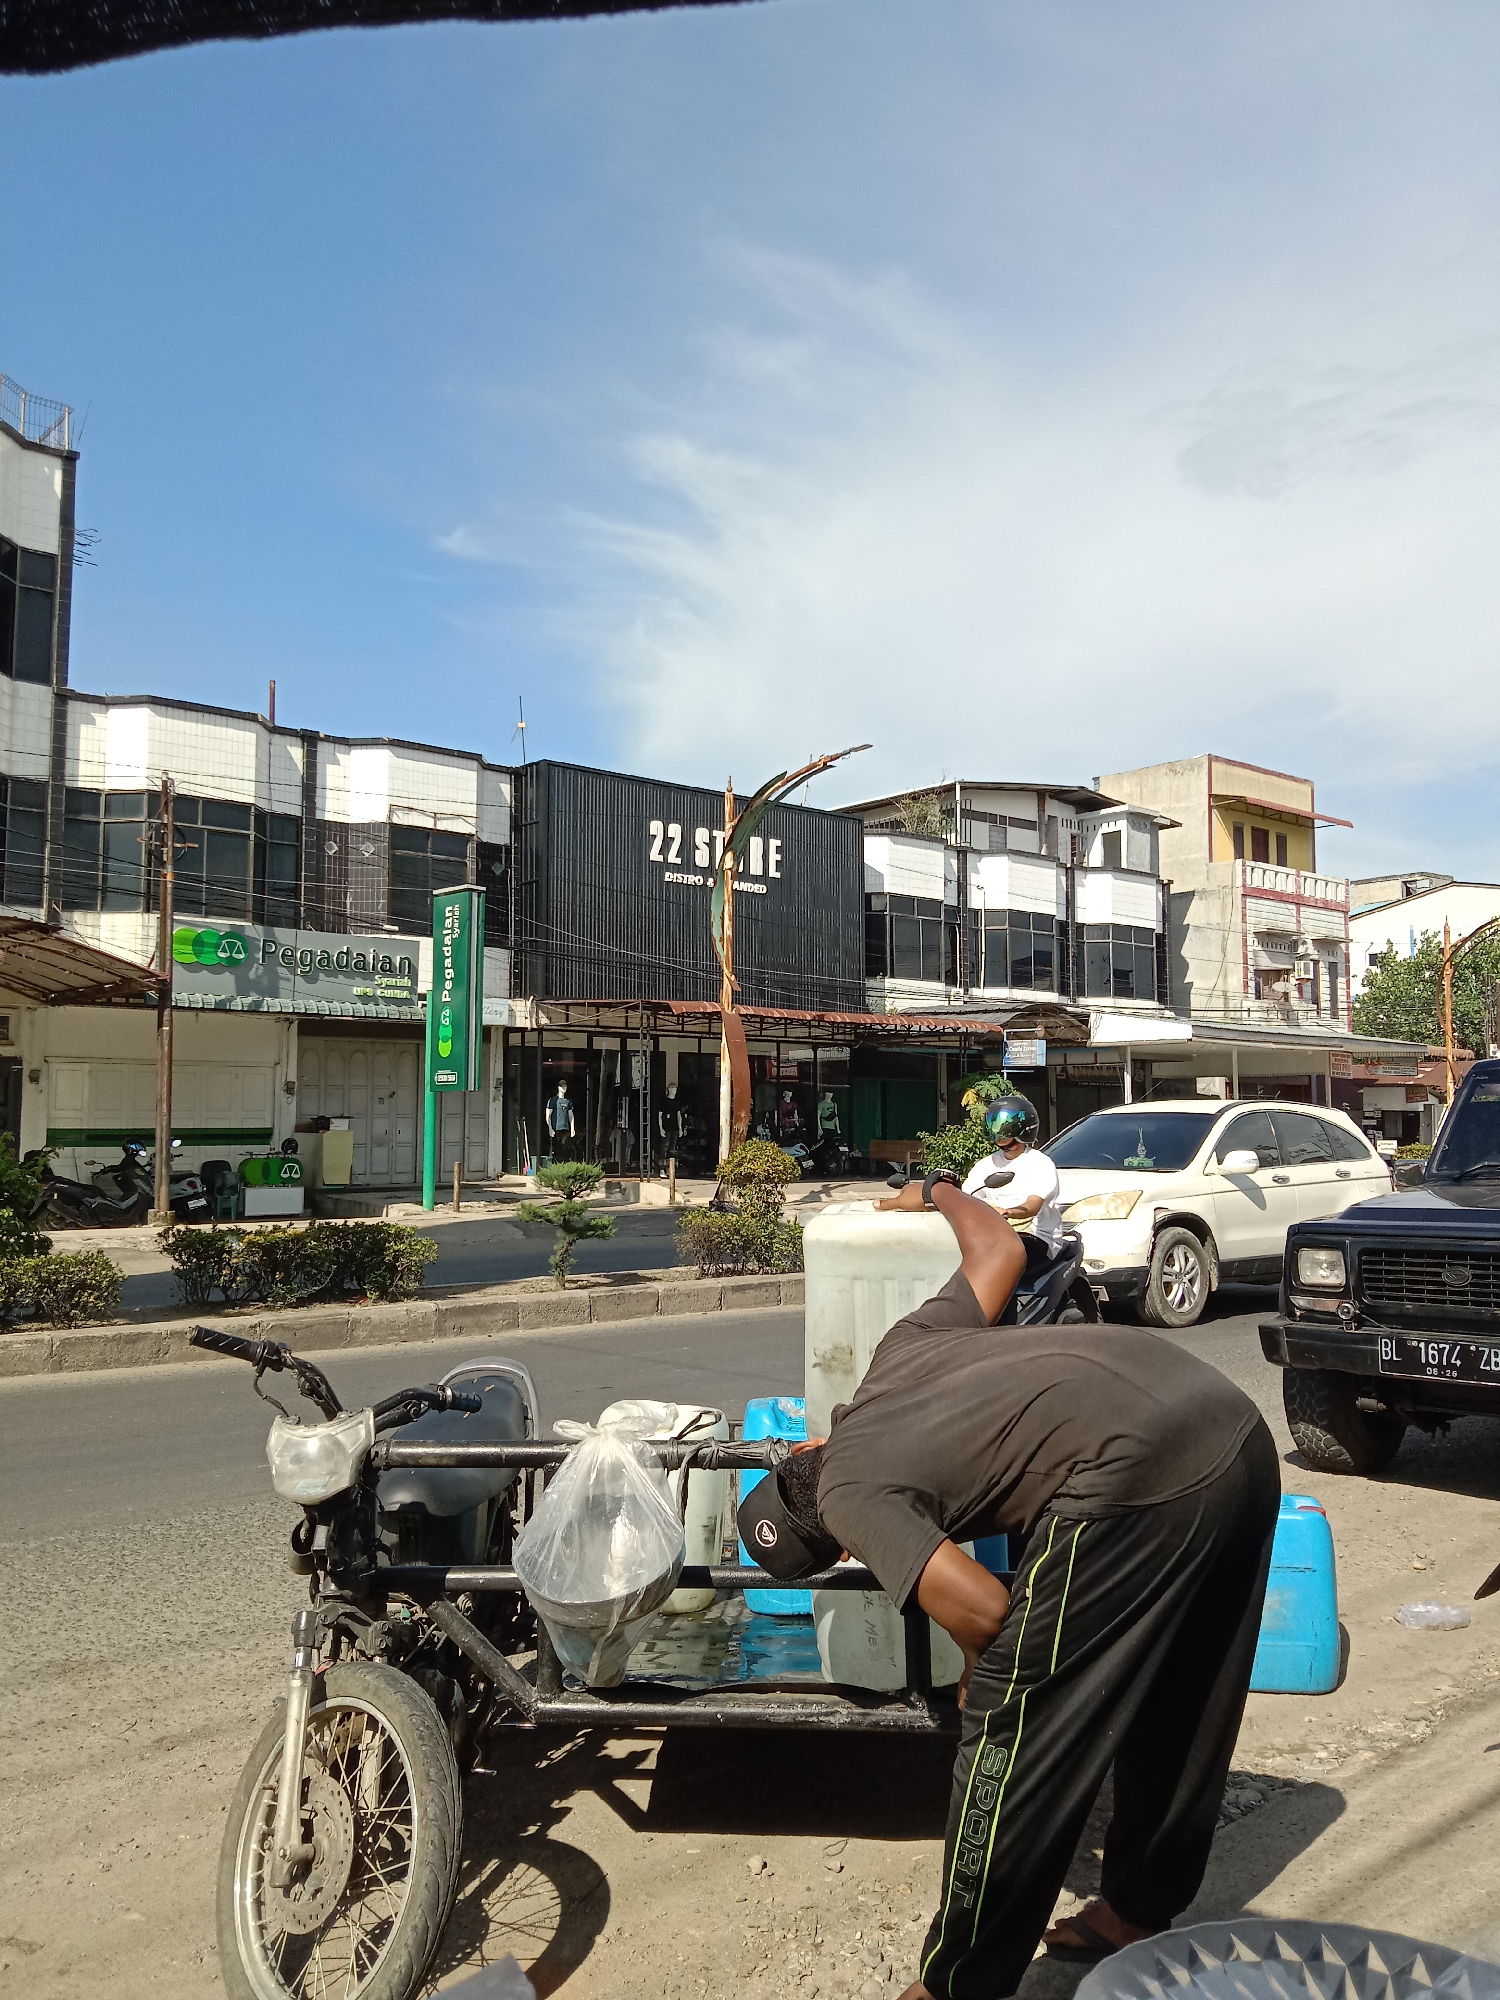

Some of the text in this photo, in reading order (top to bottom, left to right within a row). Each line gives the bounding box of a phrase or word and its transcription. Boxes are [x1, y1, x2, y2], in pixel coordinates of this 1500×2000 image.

[649, 820, 782, 879] 22 STRE
[664, 871, 704, 886] DISTRO
[732, 880, 767, 894] ANDED
[452, 904, 461, 938] Syariah
[259, 938, 412, 976] Pegadaian
[442, 906, 454, 1003] Pegadaian
[374, 975, 412, 987] Syariah
[1381, 1338, 1402, 1361] BL
[1419, 1341, 1461, 1368] 1674
[953, 1745, 1008, 1909] SPORT
